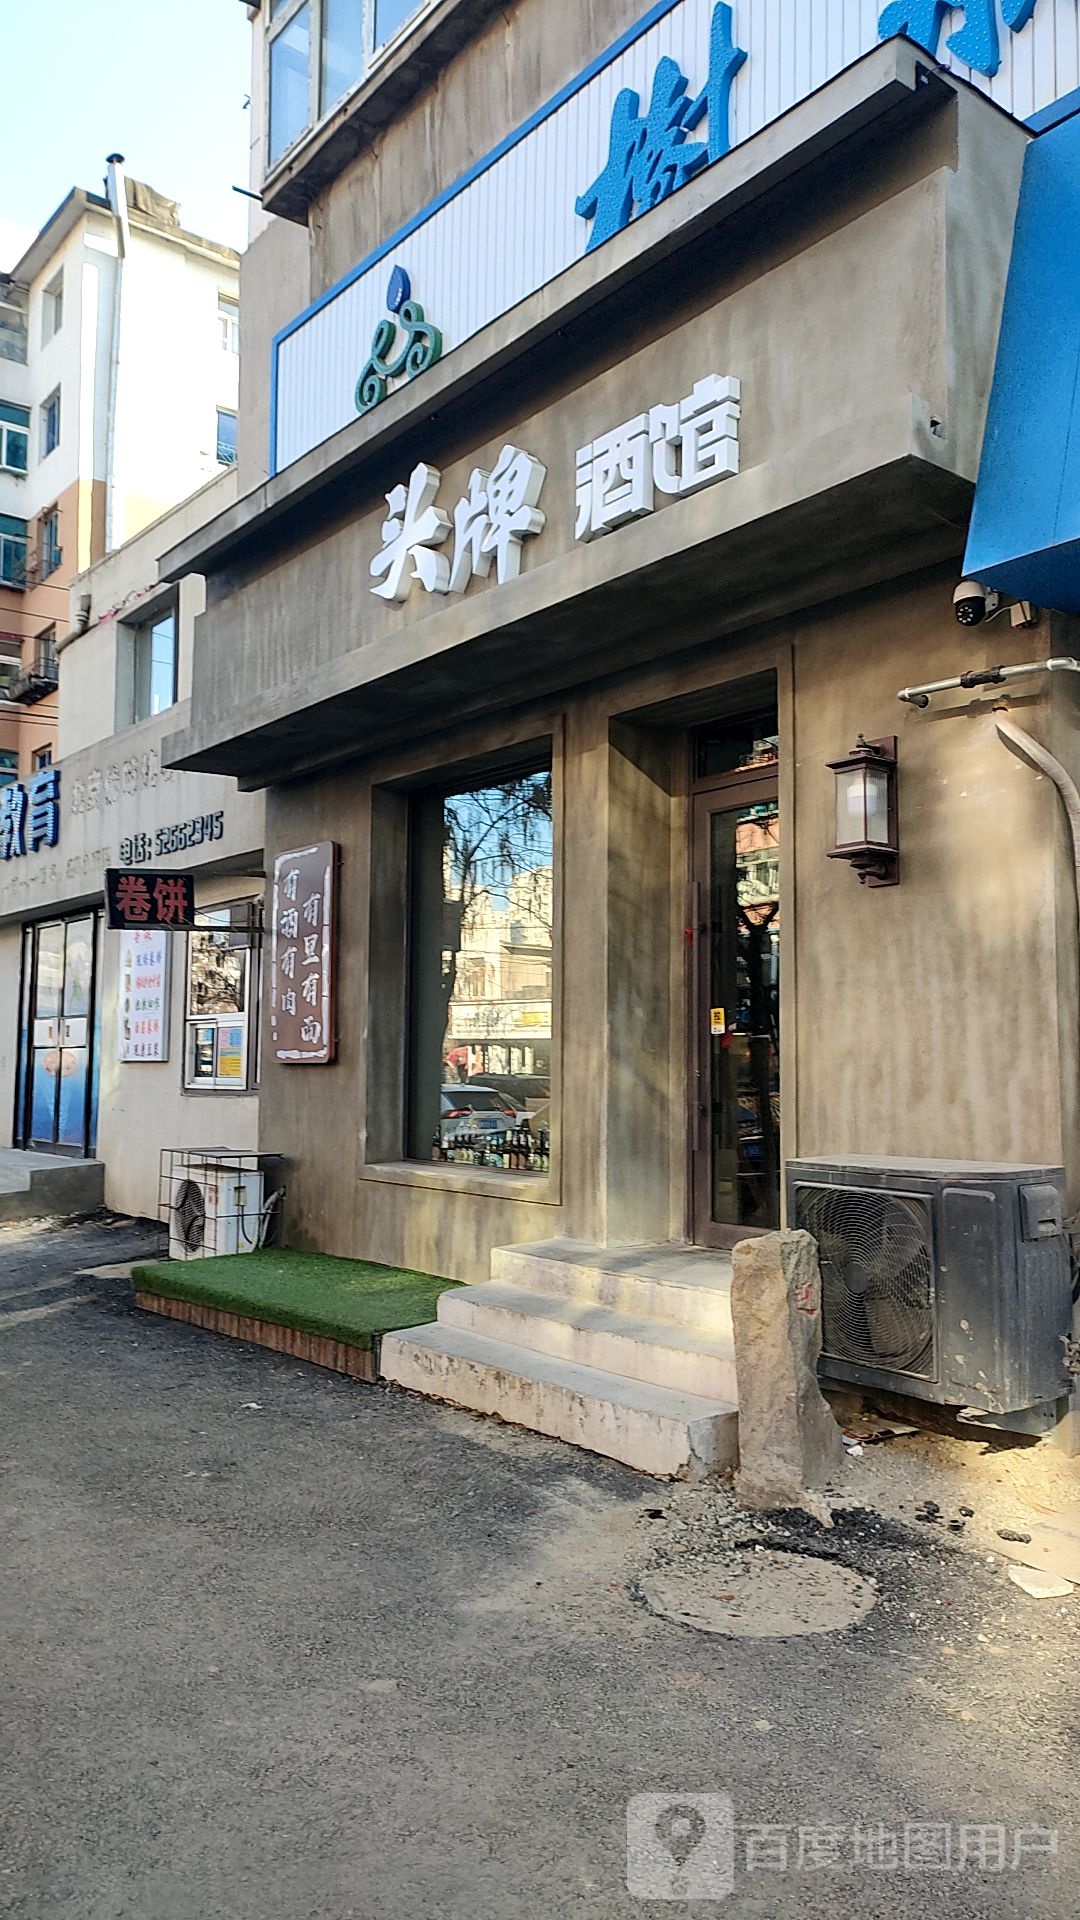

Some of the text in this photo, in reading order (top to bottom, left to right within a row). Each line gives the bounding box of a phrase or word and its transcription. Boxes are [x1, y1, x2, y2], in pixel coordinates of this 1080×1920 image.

[369, 373, 742, 602] 头牌 酒馆
[116, 876, 189, 924] 卷饼
[280, 868, 300, 1016] 有酒有肉
